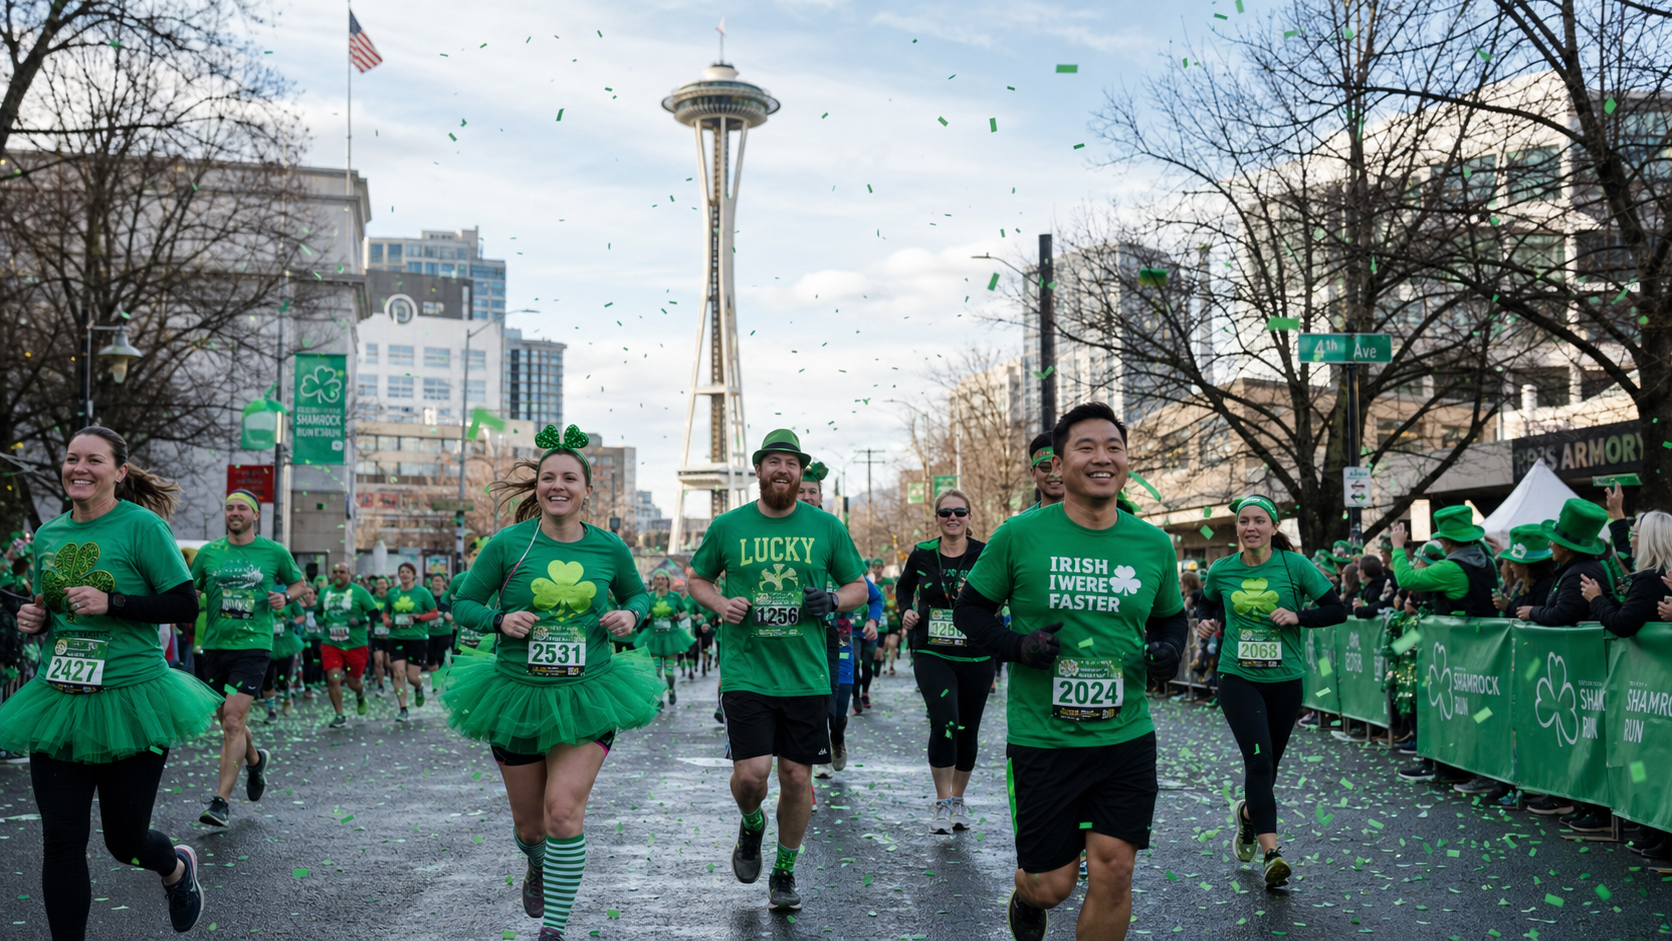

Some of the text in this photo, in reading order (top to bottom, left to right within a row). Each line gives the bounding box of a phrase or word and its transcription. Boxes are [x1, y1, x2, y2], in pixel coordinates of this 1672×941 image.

[1313, 339, 1377, 359] 4th Ave
[296, 414, 341, 426] SHAMROCK
[740, 536, 815, 567] LUCKY
[1050, 556, 1108, 575] IRISH
[1049, 593, 1120, 612] FASTER
[757, 607, 798, 625] 1256
[531, 643, 580, 664] 2531
[1240, 643, 1278, 659] 2068
[49, 658, 98, 682] 2427
[1058, 680, 1118, 705] 2024
[1453, 672, 1500, 696] SHAMROCK
[1623, 718, 1644, 743] RUN
